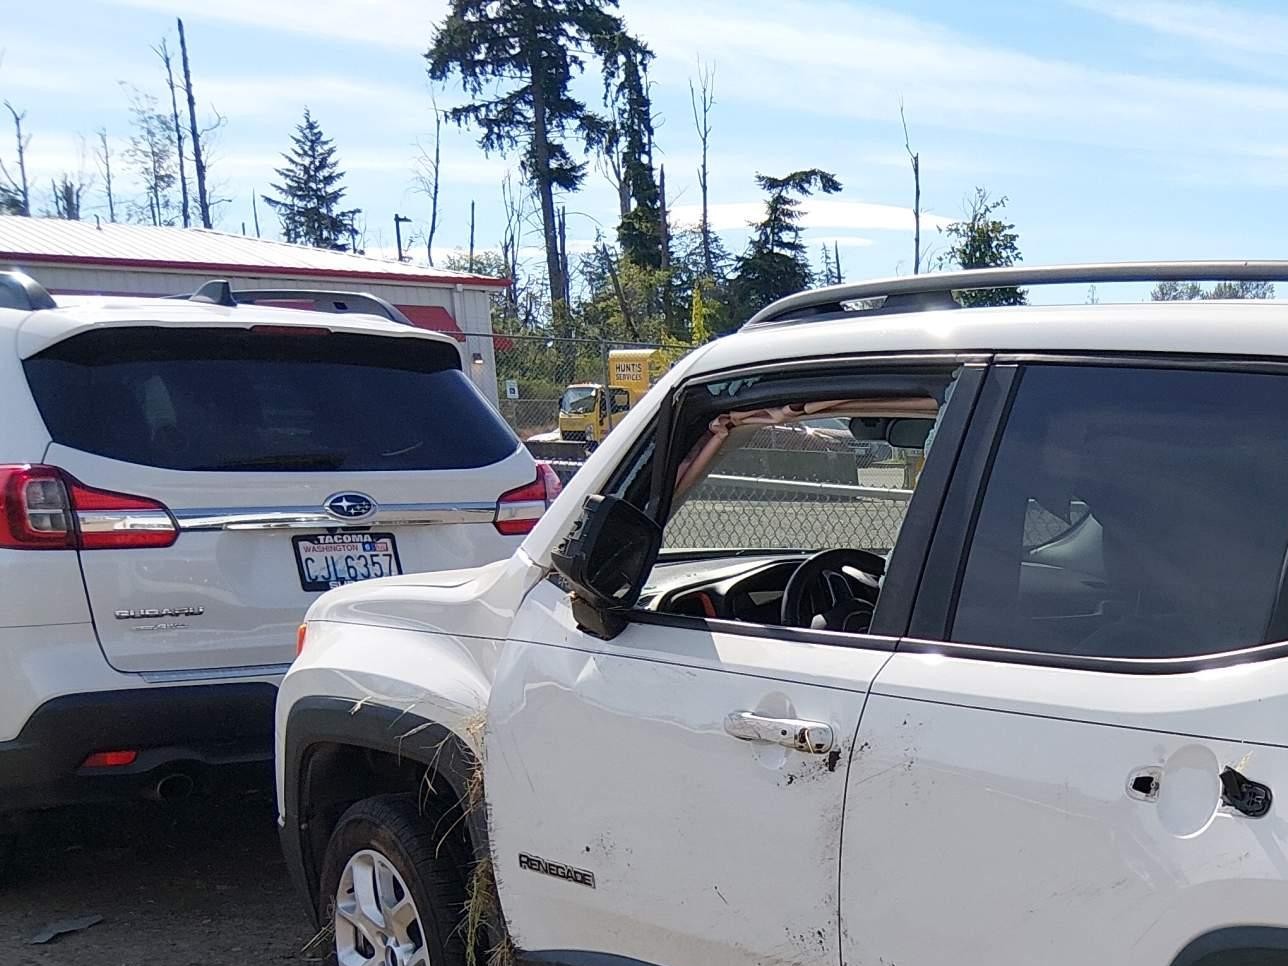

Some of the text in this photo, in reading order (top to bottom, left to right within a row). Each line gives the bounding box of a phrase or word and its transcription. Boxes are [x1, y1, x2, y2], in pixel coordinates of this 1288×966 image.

[615, 363, 642, 373] HUNT'S
[316, 534, 373, 545] TACOMA
[303, 545, 359, 553] WASHINGTON
[304, 554, 392, 582] CJL6357
[114, 606, 205, 619] SUBARU
[518, 853, 595, 888] RENEGADE
